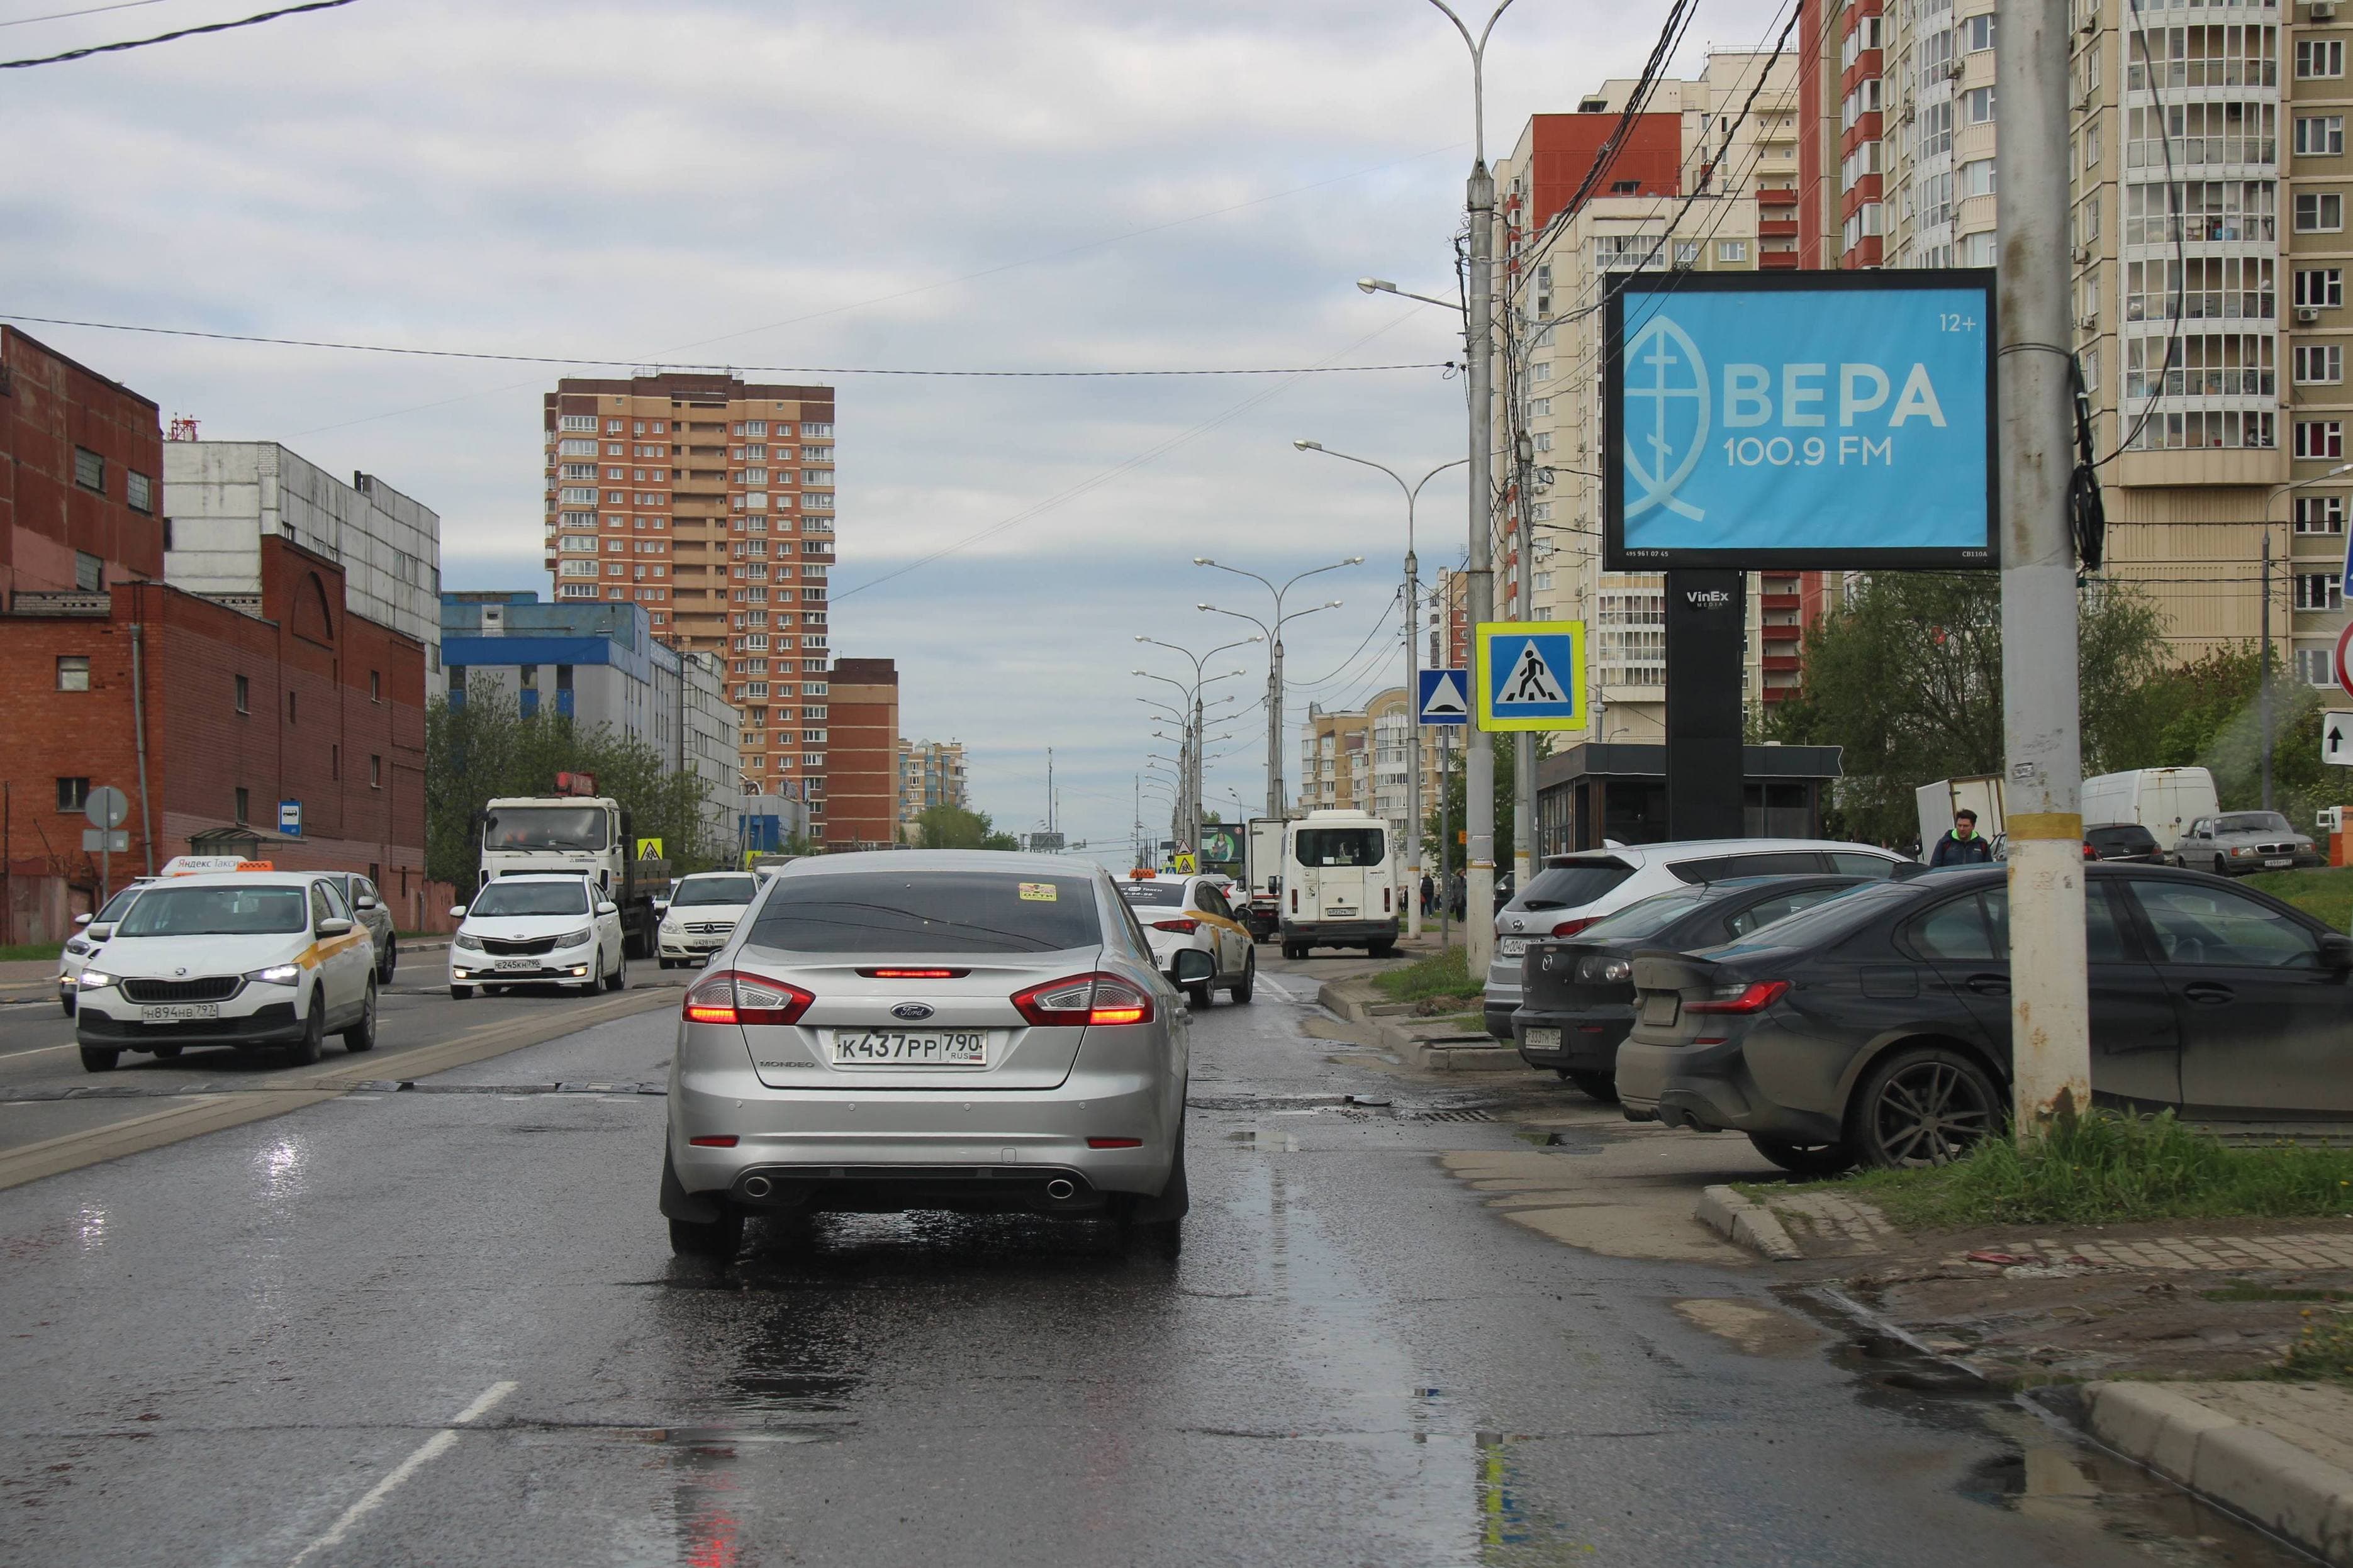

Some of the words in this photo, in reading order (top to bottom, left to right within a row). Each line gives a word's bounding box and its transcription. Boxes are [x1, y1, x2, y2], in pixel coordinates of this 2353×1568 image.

[1940, 314, 1976, 332] 12+
[1723, 362, 1947, 428] ВЕРА
[1723, 436, 1825, 467] 100.9
[1838, 436, 1892, 465] FM
[1687, 591, 1730, 603] VinEx
[178, 859, 212, 868] Яндекс
[213, 858, 240, 867] Такси
[1506, 940, 1525, 952] У004А
[498, 961, 527, 969] Е245КН
[147, 1006, 193, 1018] Н894НВ
[196, 1004, 214, 1014] 797
[900, 1006, 925, 1016] Ford
[843, 1033, 937, 1058] К437РР
[943, 1033, 980, 1052] 790
